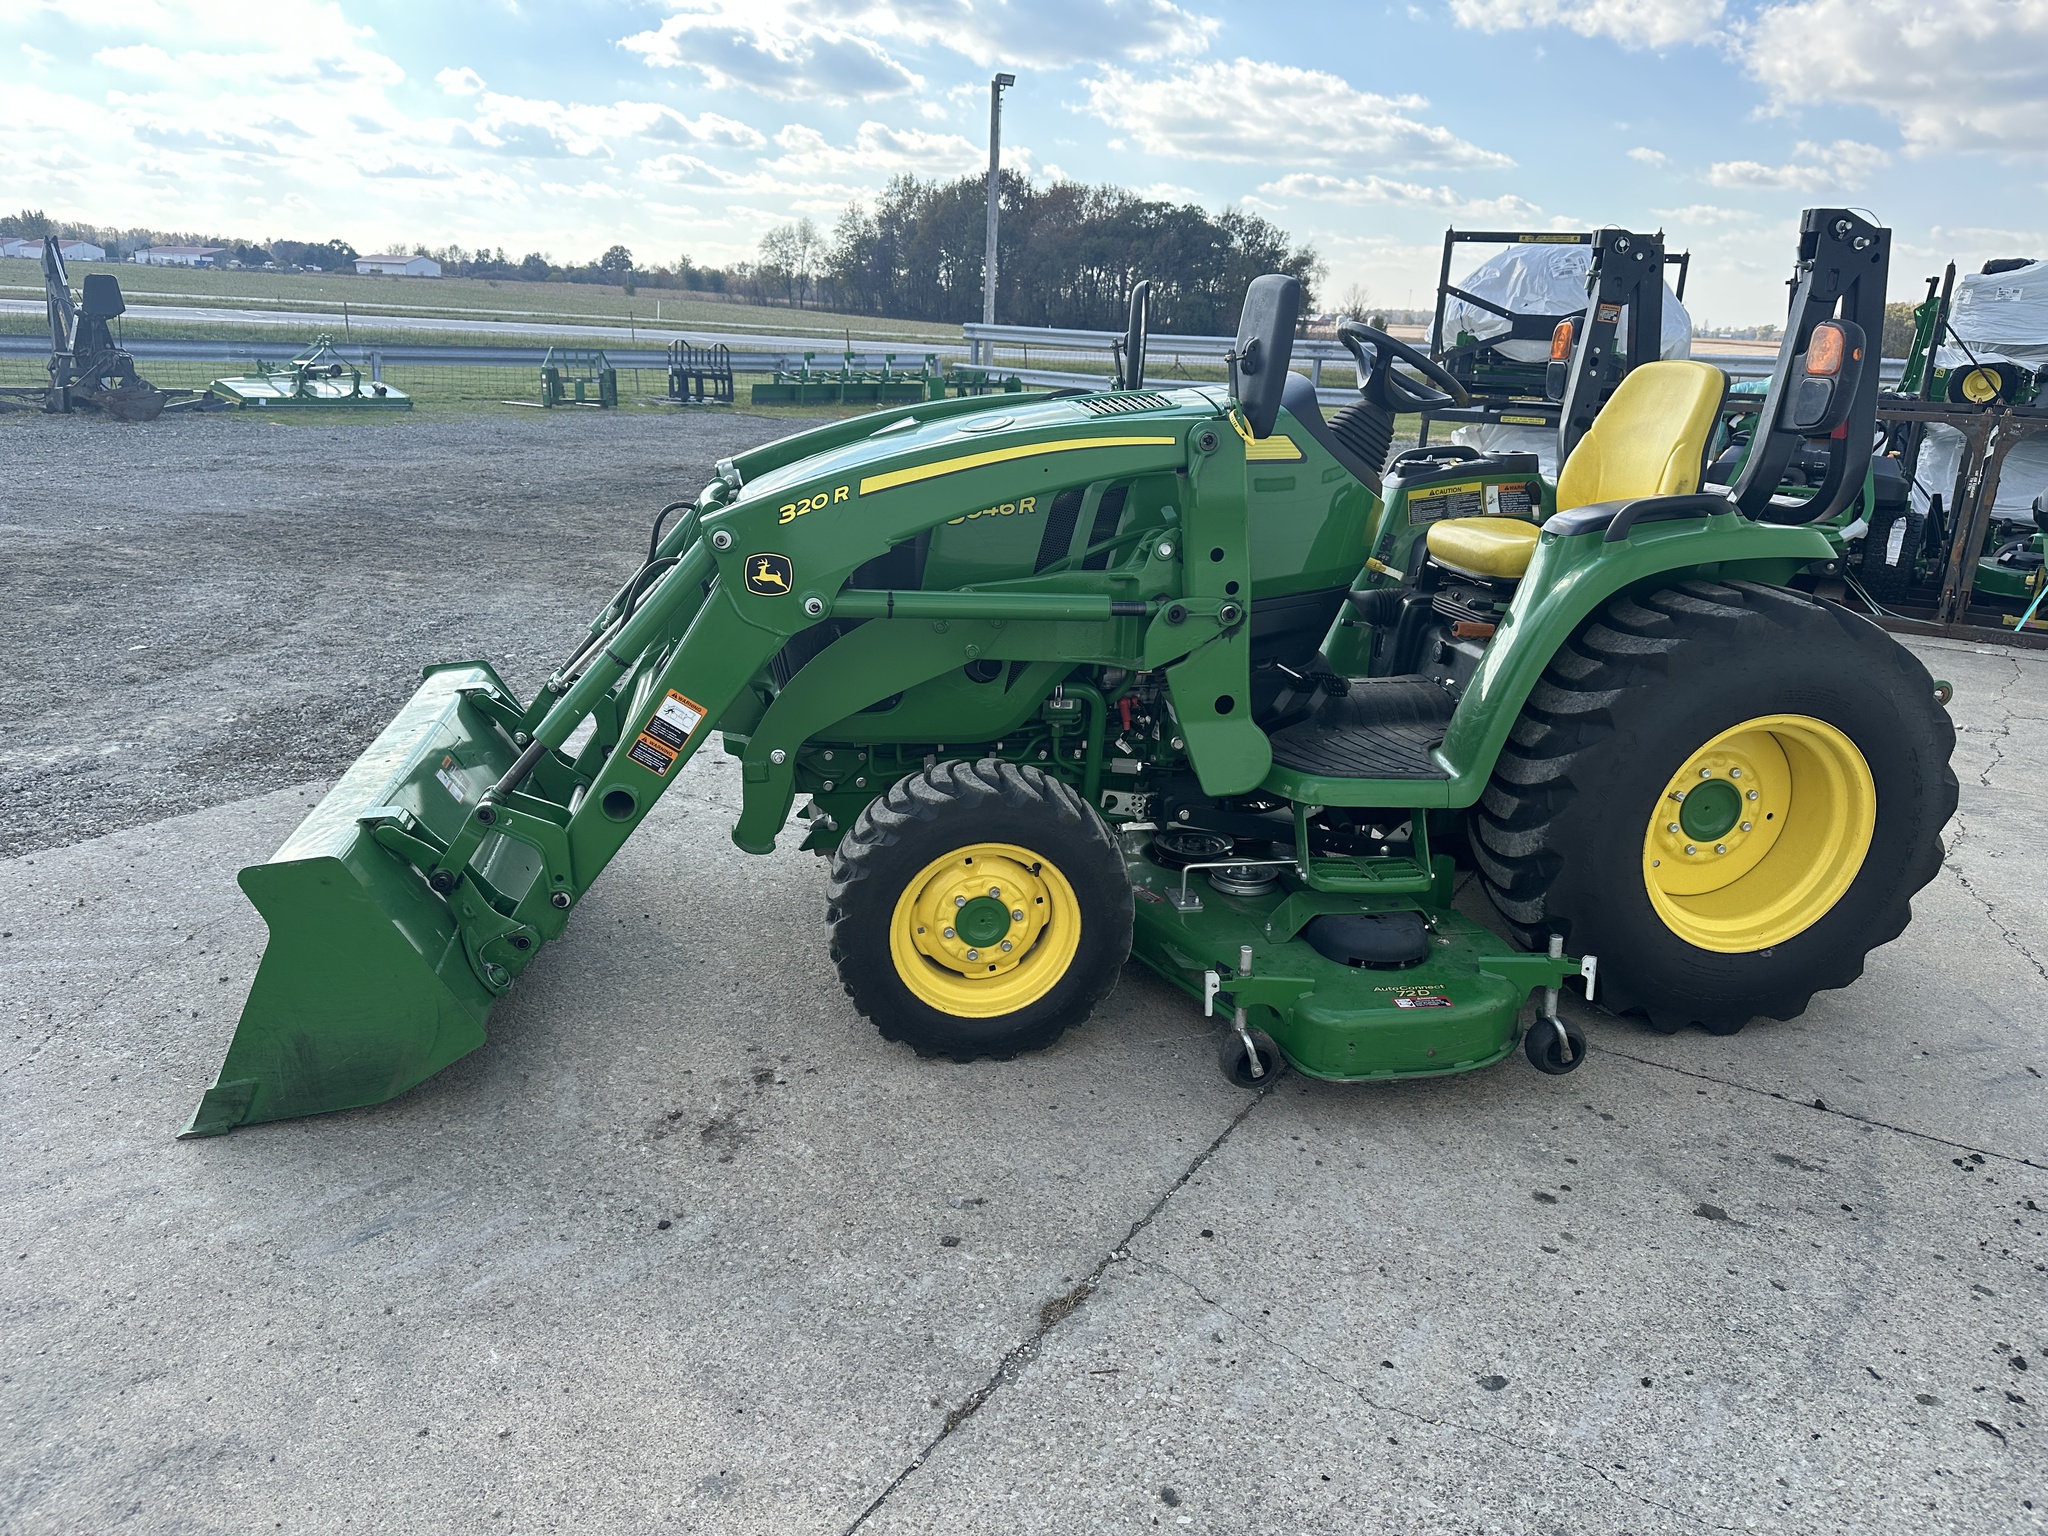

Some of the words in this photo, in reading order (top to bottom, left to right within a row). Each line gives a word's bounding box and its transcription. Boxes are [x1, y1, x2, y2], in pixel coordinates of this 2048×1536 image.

[1435, 486, 1462, 495] CAUTION
[778, 492, 829, 525] 320
[833, 485, 850, 505] R
[677, 695, 702, 713] WARNING
[649, 740, 673, 757] WARNING
[1373, 983, 1446, 992] AutoConnect
[1395, 989, 1431, 997] 72D
